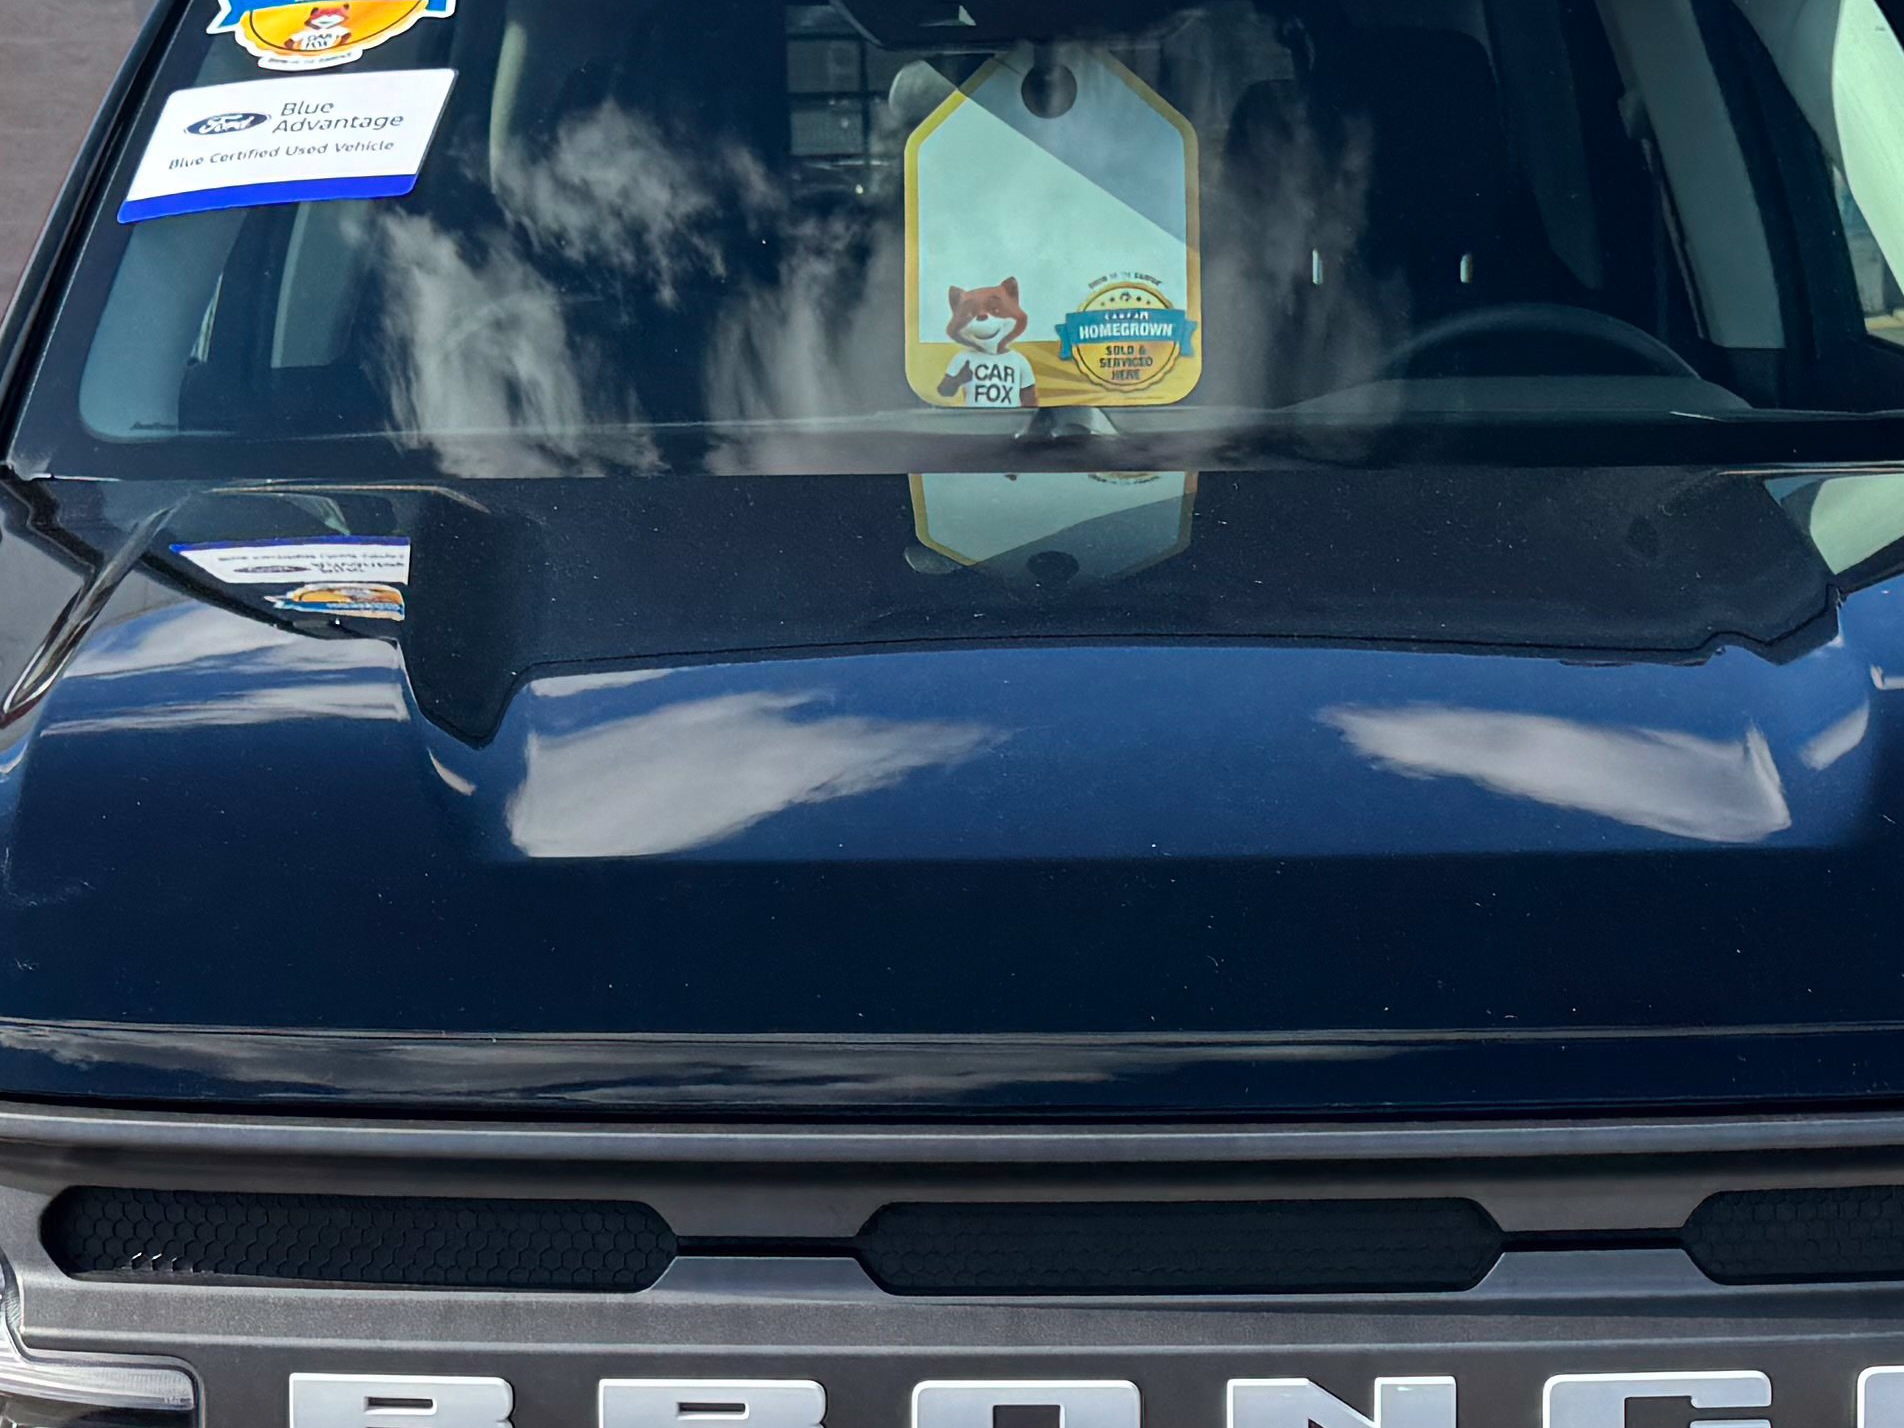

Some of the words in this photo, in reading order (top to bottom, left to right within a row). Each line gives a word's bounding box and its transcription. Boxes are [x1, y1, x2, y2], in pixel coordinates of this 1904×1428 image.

[280, 101, 334, 117] Blue
[196, 113, 260, 135] Ford
[272, 115, 404, 134] Advantage
[168, 157, 204, 170] Blue
[210, 147, 279, 164] Certified
[286, 144, 328, 156] Used
[335, 140, 394, 152] Vehicle
[1079, 323, 1173, 339] HOMEGROWN
[1105, 345, 1134, 356] SOLD
[1099, 356, 1153, 368] SERVICED
[974, 364, 1015, 383] CAR
[974, 384, 1013, 404] FOX
